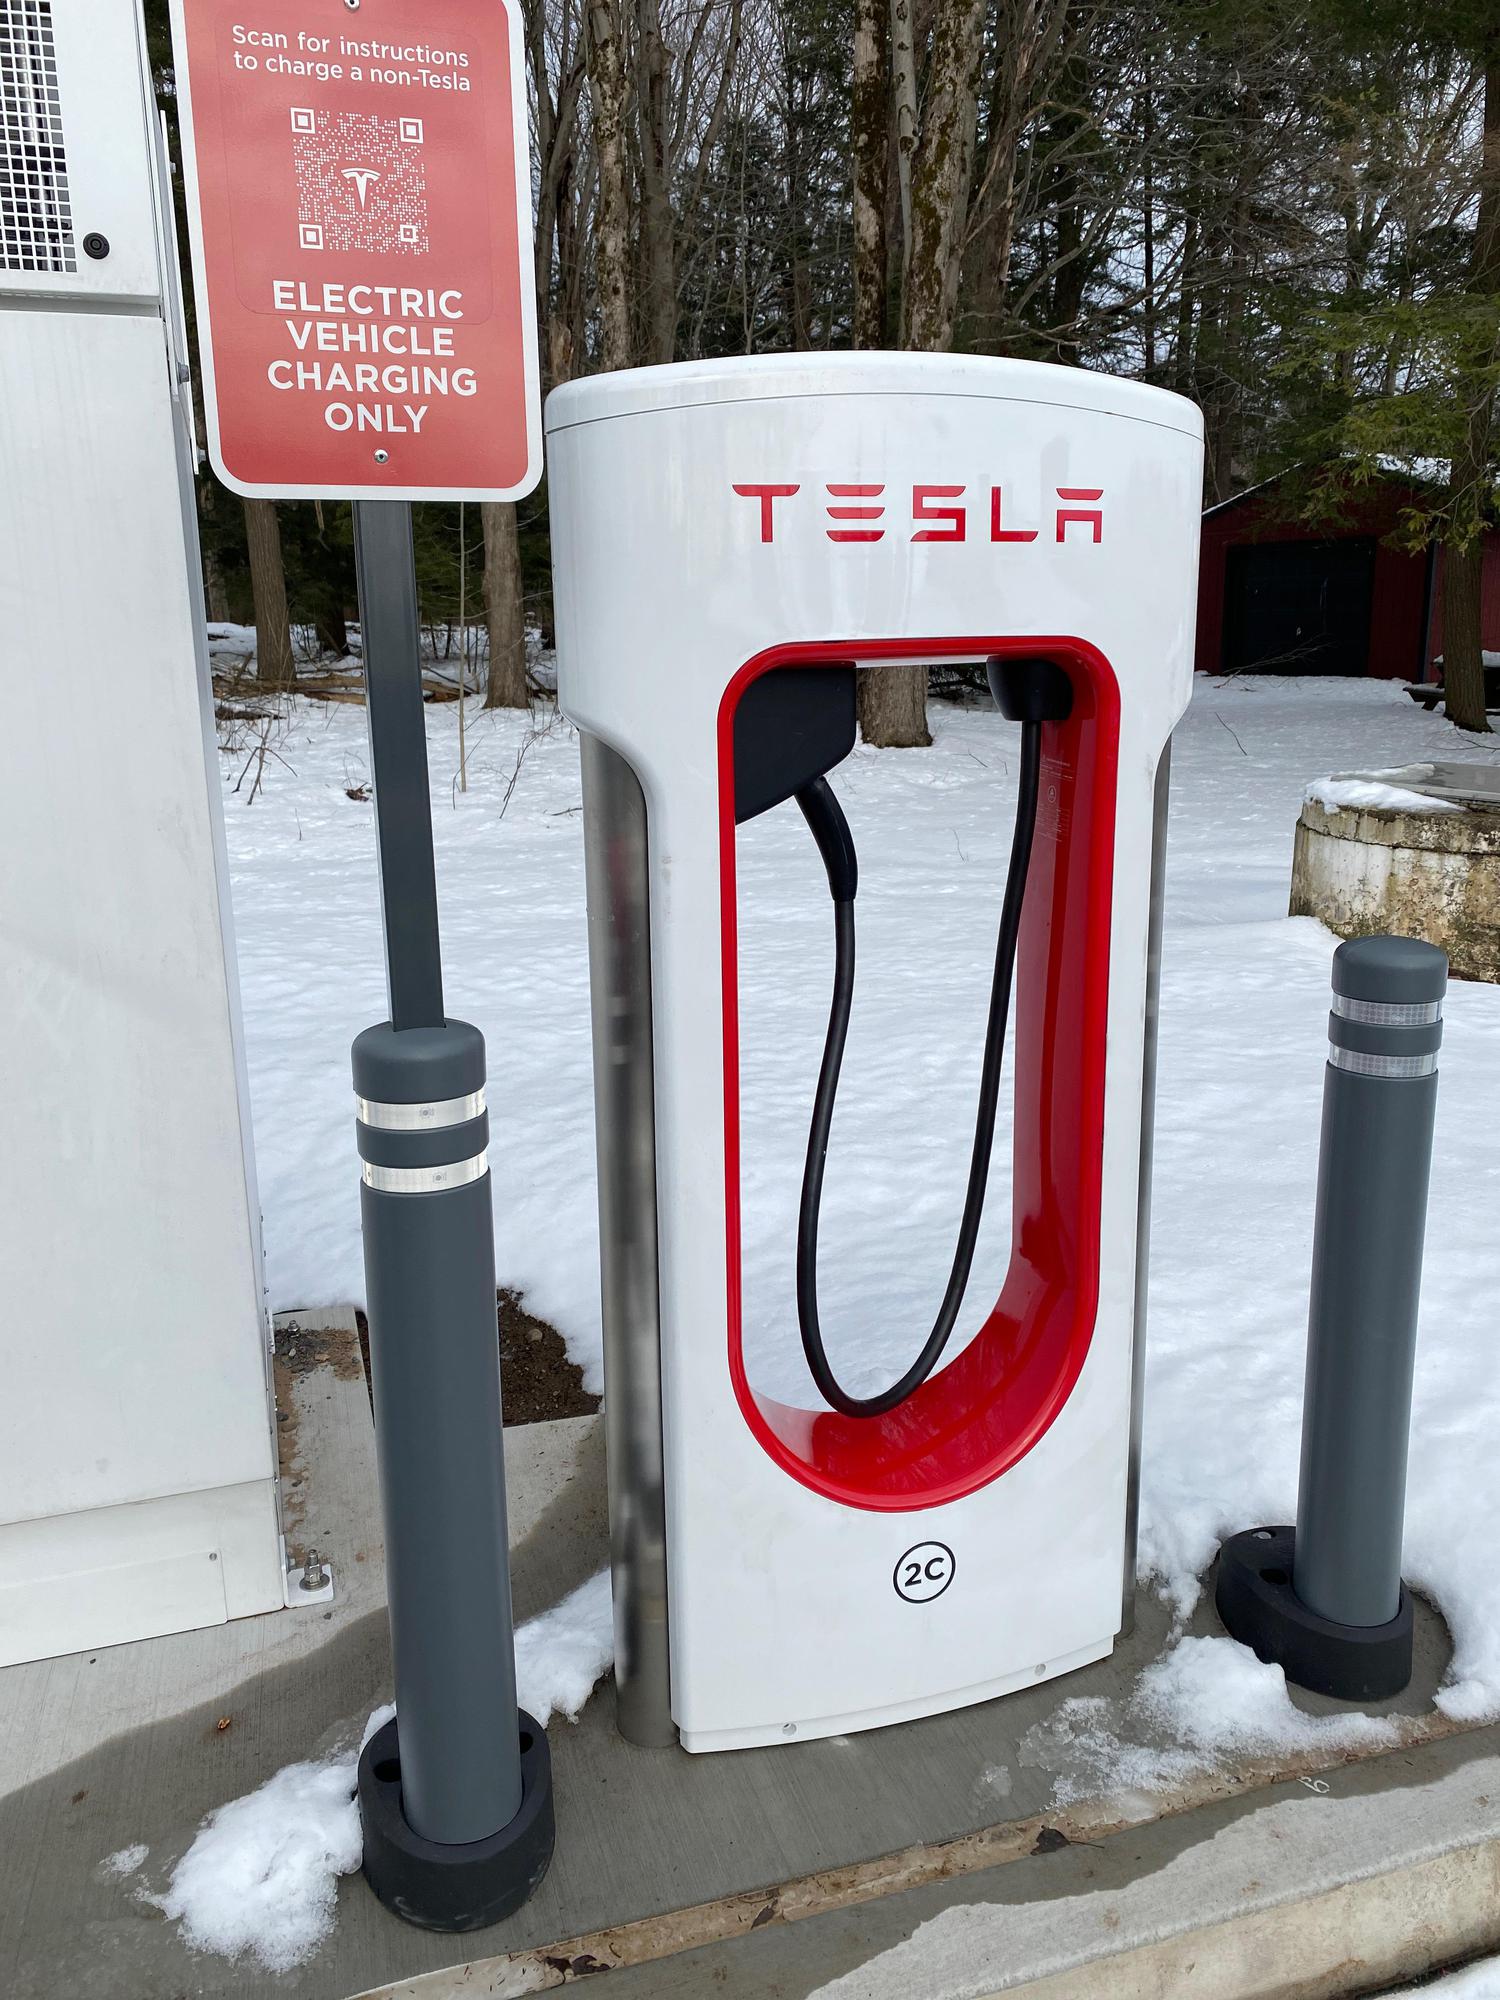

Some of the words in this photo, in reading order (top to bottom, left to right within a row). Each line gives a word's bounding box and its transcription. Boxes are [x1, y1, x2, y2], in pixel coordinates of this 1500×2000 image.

[232, 24, 288, 49] Scan
[297, 31, 330, 53] for
[340, 35, 469, 67] instructions
[233, 50, 258, 70] to
[265, 53, 343, 81] charge
[350, 66, 363, 81] a
[370, 68, 471, 92] non-Tesla
[272, 280, 464, 319] ELECTRIC
[285, 319, 455, 357] VEHICLE
[267, 360, 477, 396] CHARGING
[324, 402, 428, 433] ONLY
[732, 484, 1104, 543] TESLA
[904, 1556, 945, 1587] 2C
